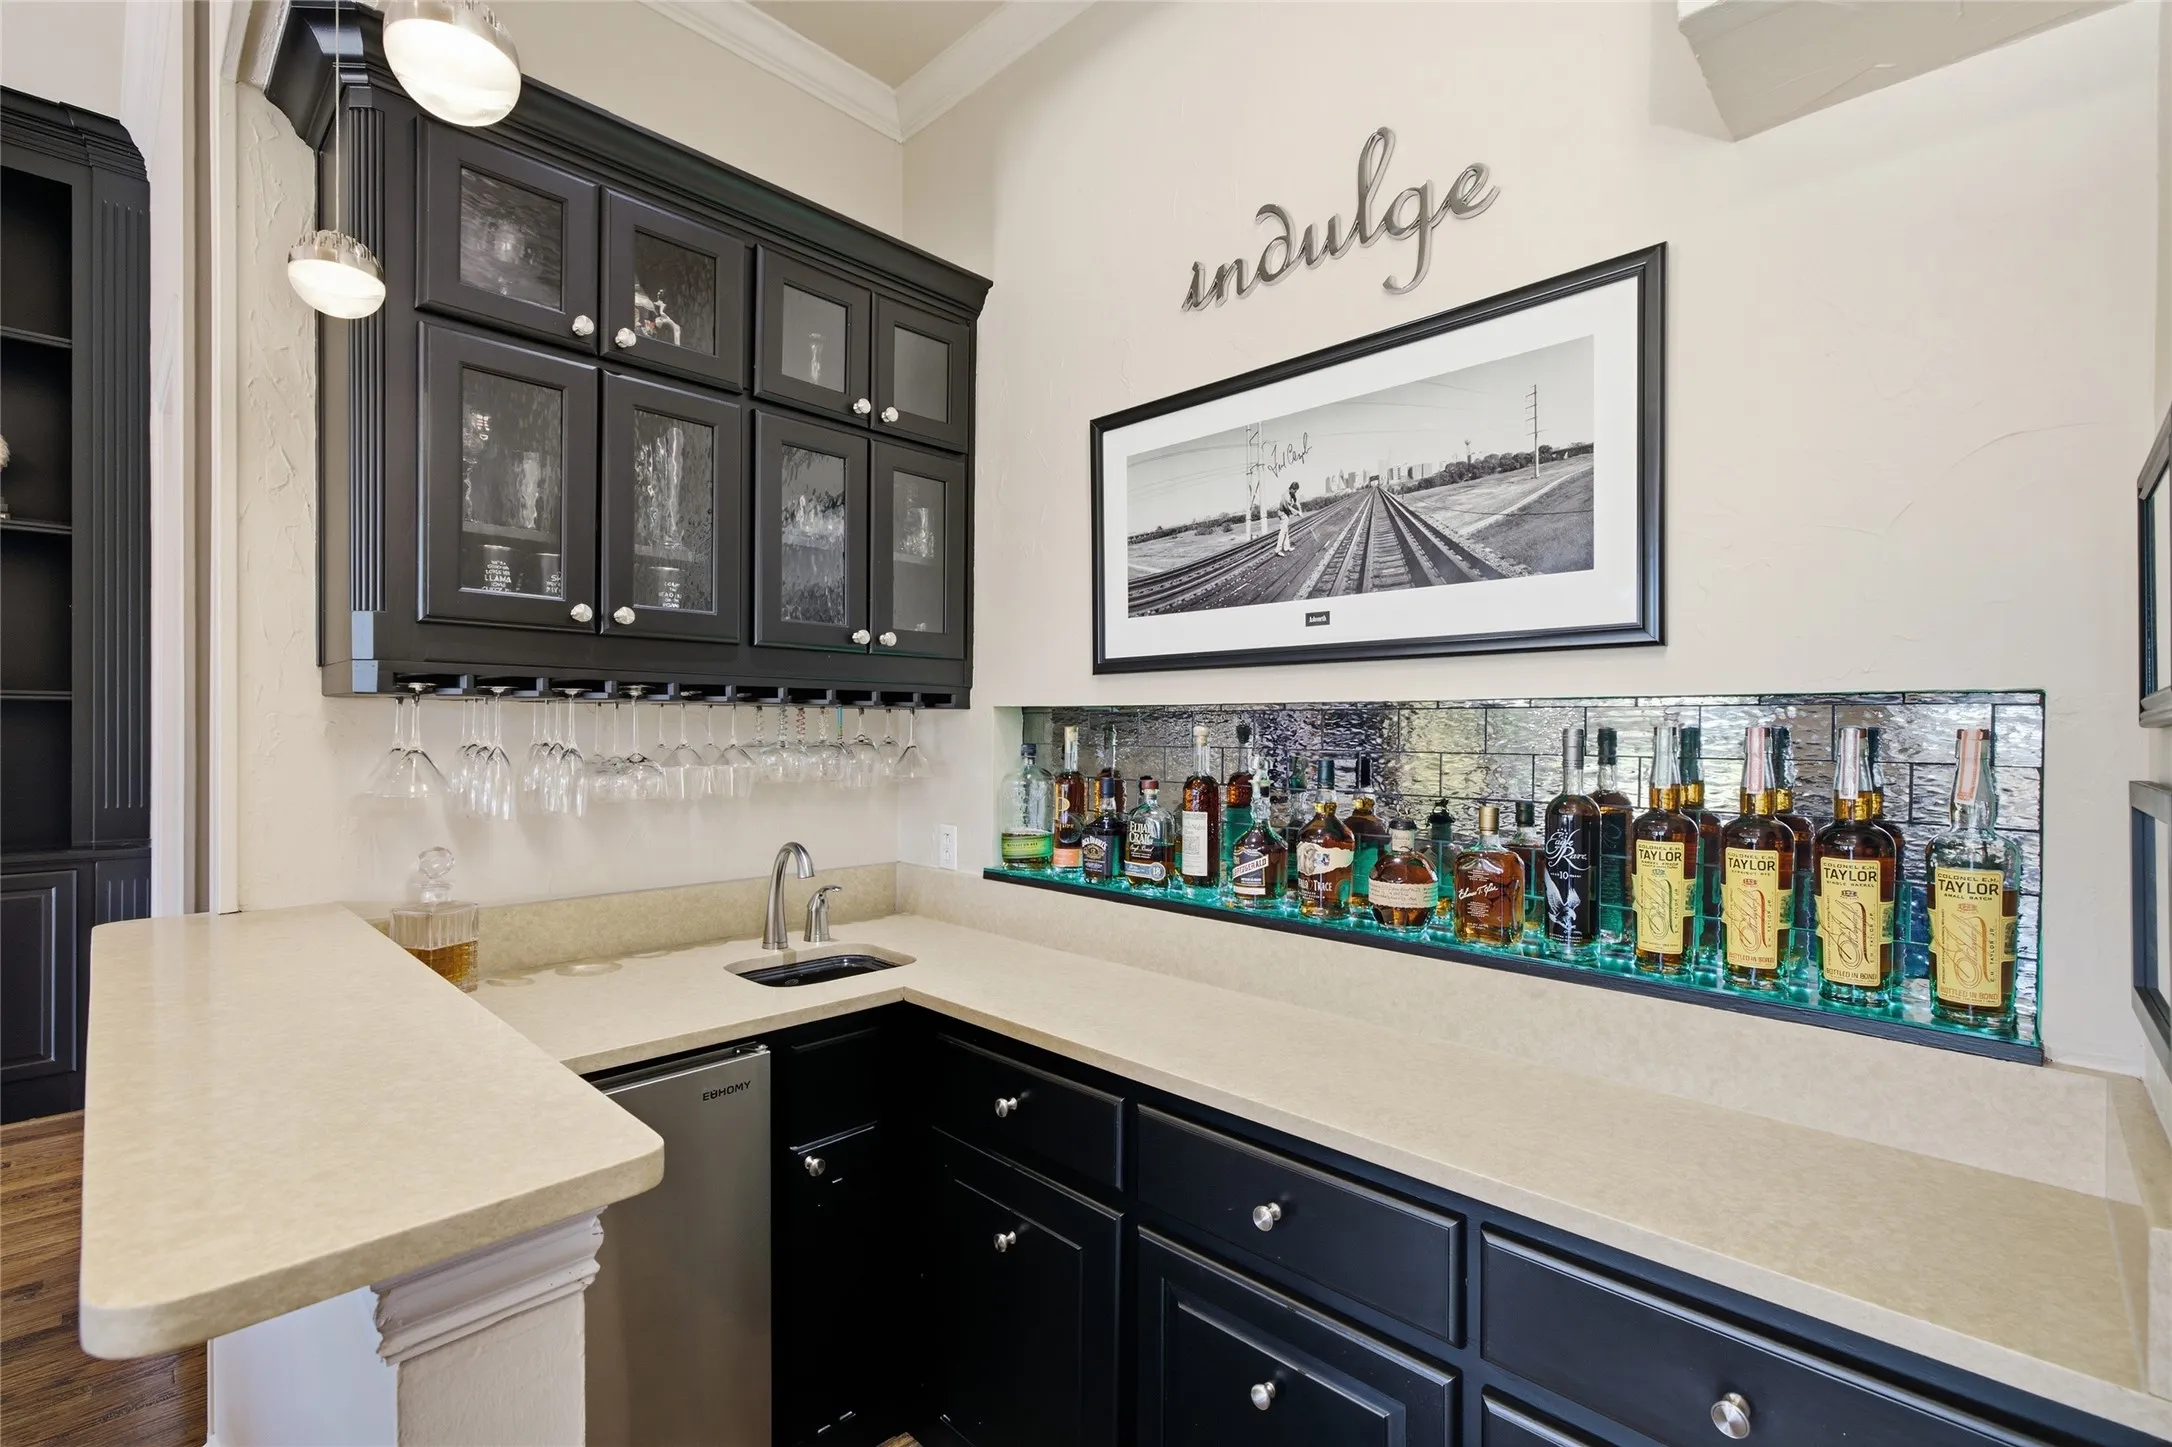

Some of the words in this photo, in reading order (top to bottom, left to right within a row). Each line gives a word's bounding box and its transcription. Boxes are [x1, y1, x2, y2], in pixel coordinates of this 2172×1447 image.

[1182, 127, 1501, 312] indulge
[1129, 831, 1154, 845] CRAIG
[1638, 849, 1682, 862] TAYLOR
[1152, 866, 1161, 876] 18
[1728, 857, 1776, 871] TAYLOR
[1560, 871, 1569, 880] 10
[1823, 867, 1877, 882] TAYLOR
[1938, 872, 1979, 882] COLONEL
[1938, 879, 1999, 896] TAYLOR
[1825, 967, 1850, 977] BOTTLED
[1940, 985, 1968, 997] BOTTLED
[1979, 992, 1999, 1000] BOND
